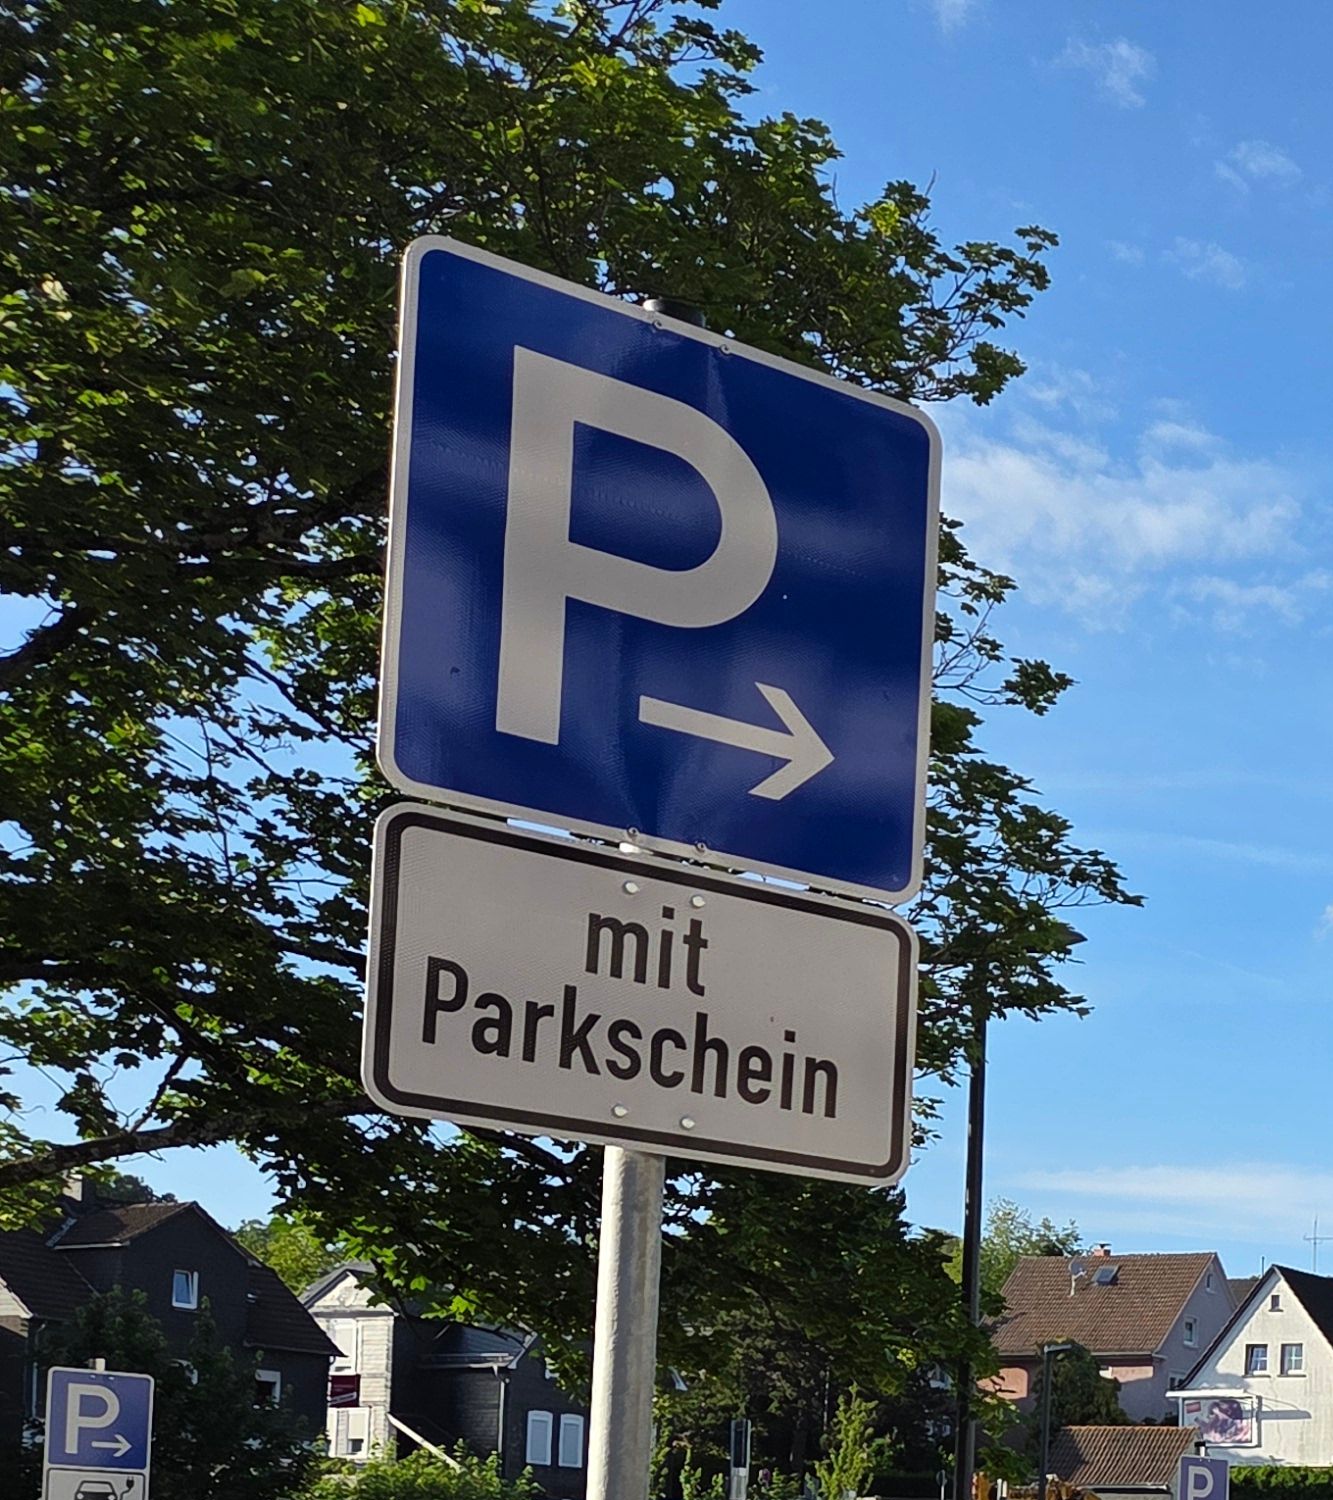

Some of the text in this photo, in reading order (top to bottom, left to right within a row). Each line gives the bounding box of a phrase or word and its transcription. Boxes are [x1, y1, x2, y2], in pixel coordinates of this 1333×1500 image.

[494, 344, 778, 746] P
[584, 906, 709, 998] mit
[421, 955, 839, 1119] Parkschein
[64, 1382, 121, 1455] P
